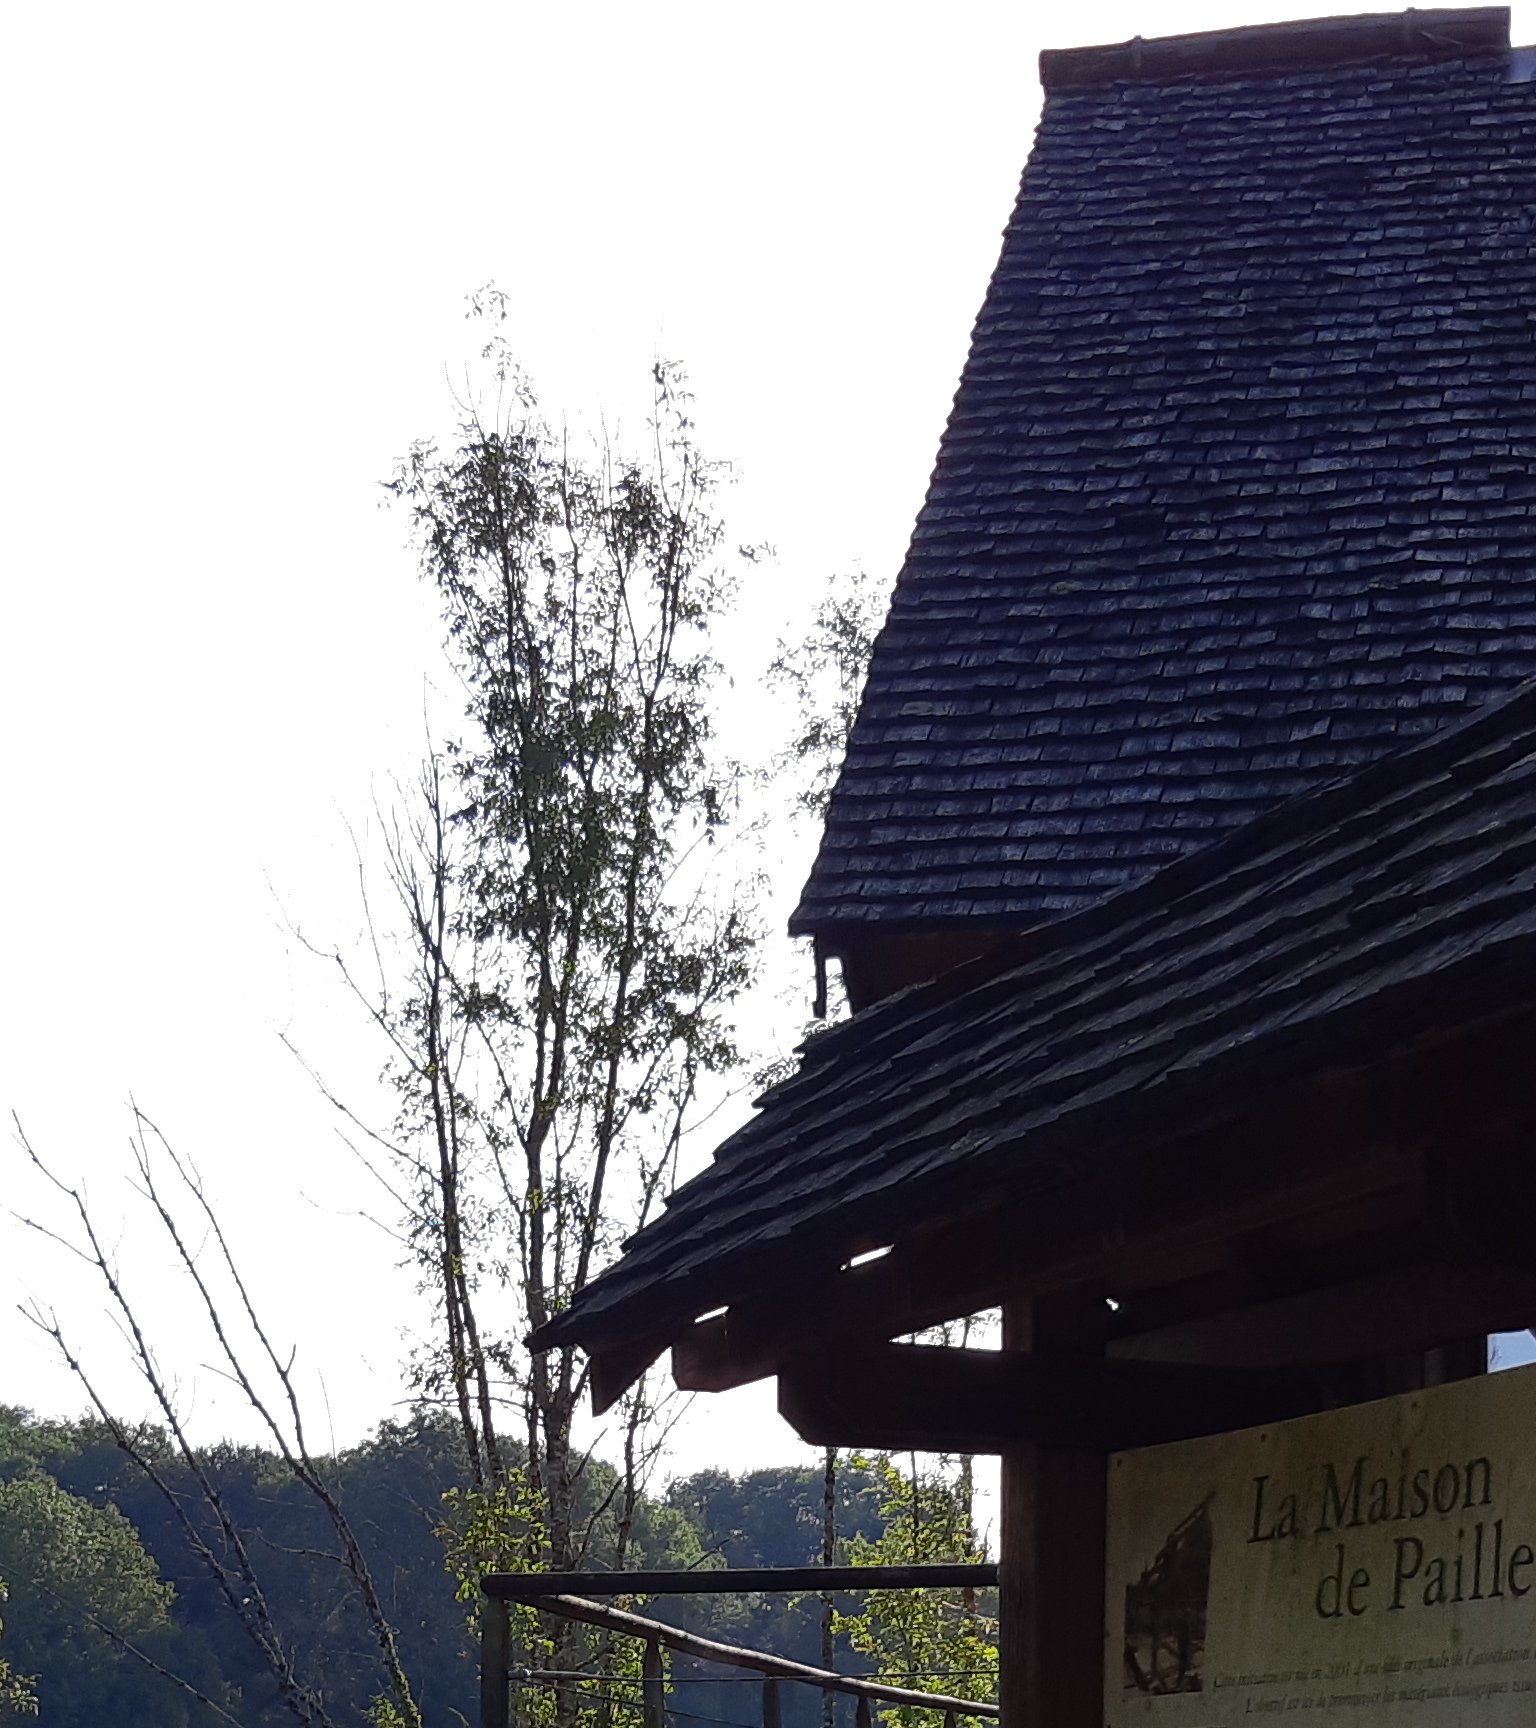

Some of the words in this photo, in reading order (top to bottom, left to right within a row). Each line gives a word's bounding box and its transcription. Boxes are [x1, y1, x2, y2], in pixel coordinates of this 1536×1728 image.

[1247, 1475, 1299, 1543] La
[1318, 1456, 1492, 1532] Maison
[1316, 1544, 1369, 1618] de
[1390, 1521, 1535, 1610] Paille
